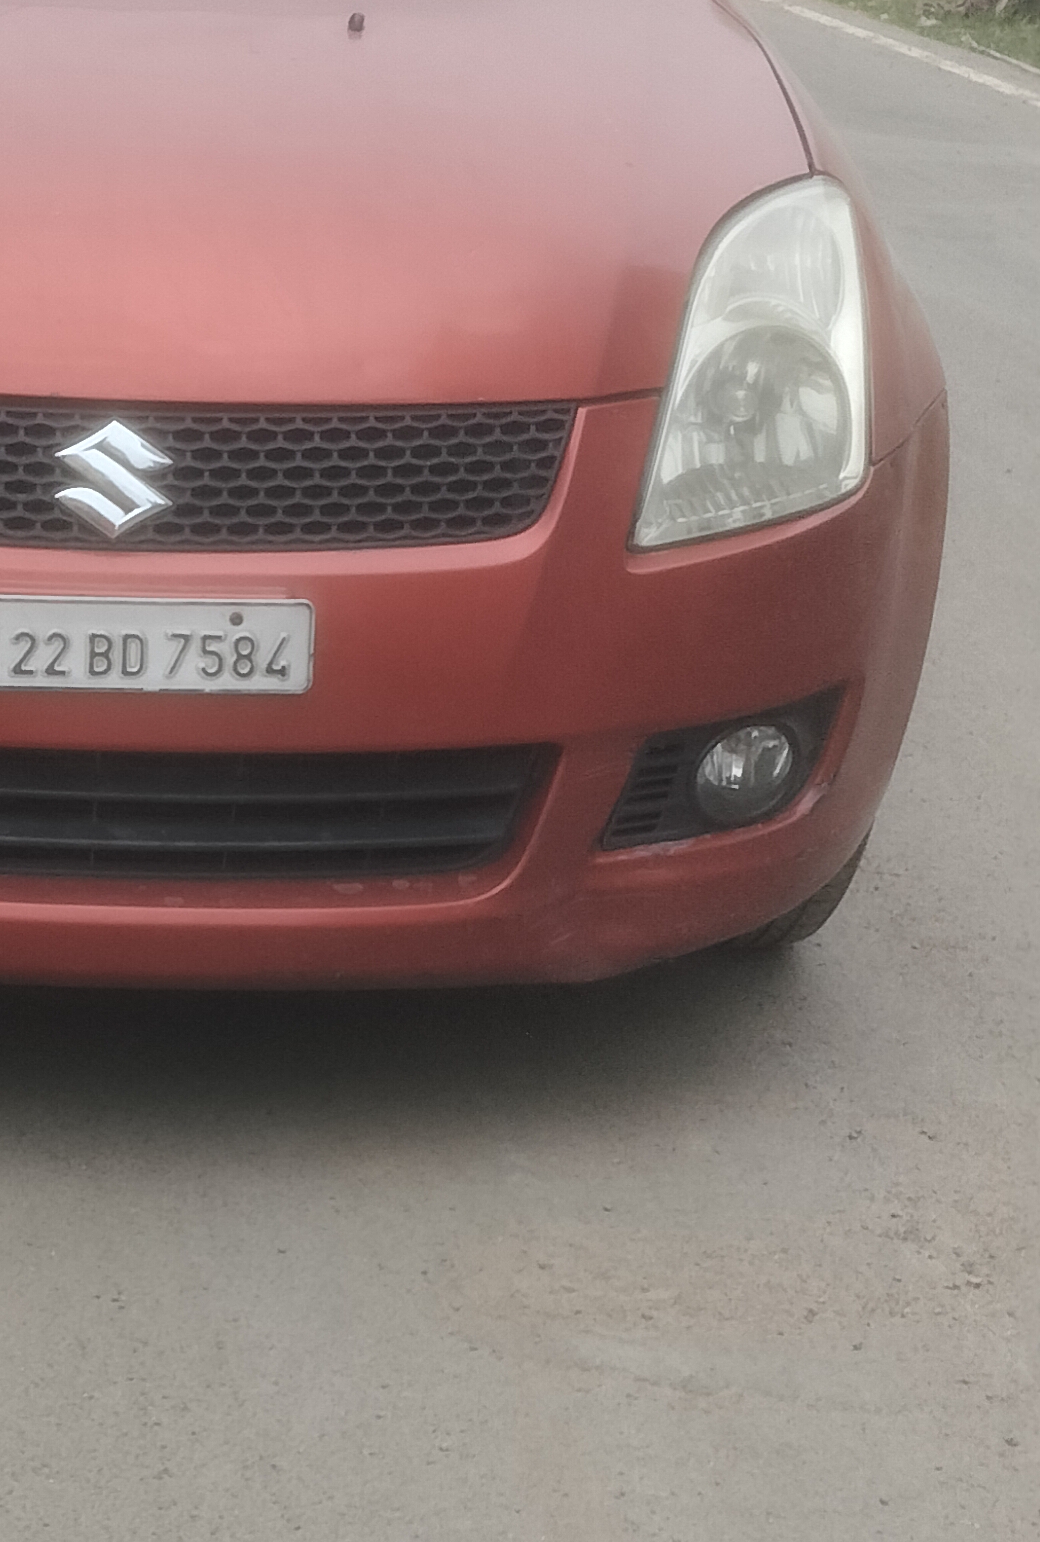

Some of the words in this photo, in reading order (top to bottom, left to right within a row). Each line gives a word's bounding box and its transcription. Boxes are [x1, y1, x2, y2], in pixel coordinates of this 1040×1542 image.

[10, 632, 70, 676] 22
[87, 632, 145, 678] BD
[165, 632, 291, 679] 7584
